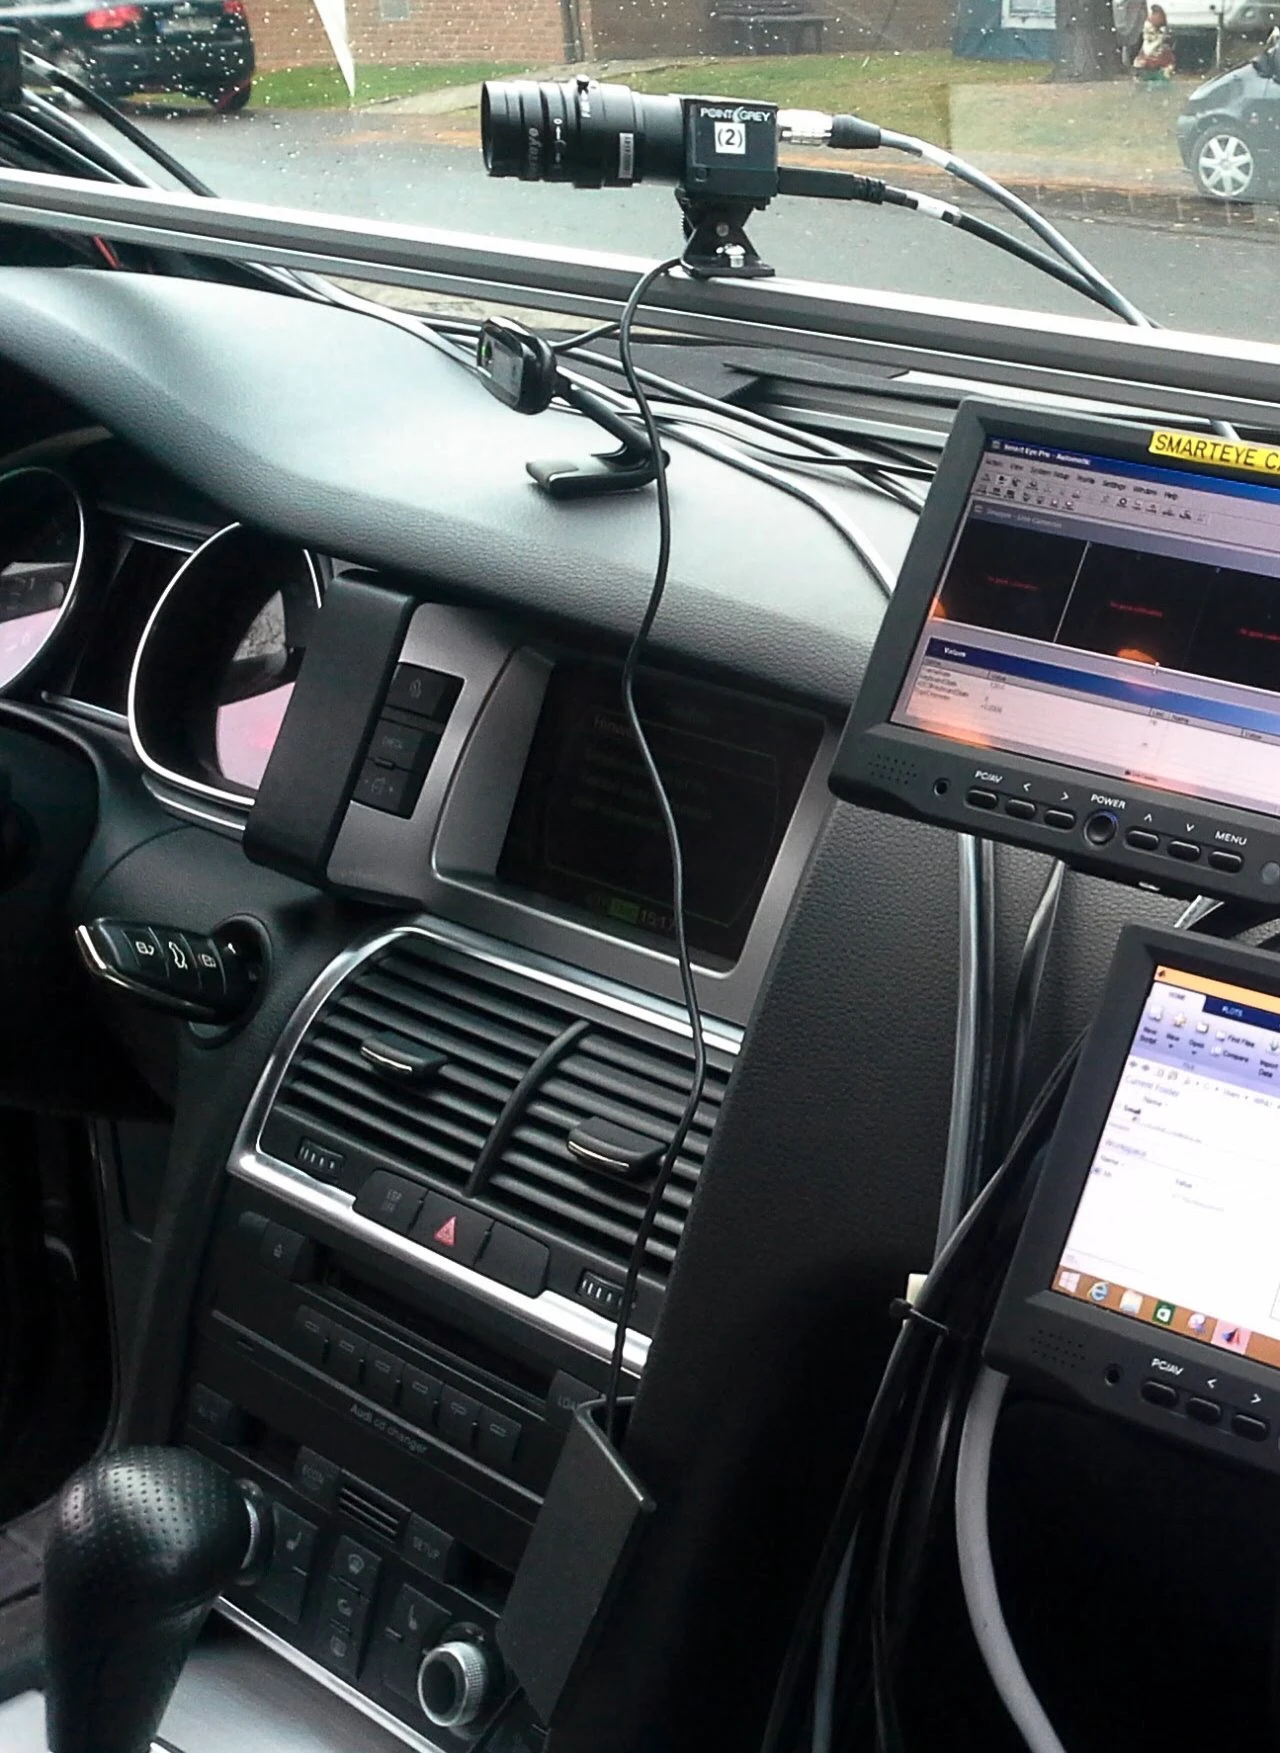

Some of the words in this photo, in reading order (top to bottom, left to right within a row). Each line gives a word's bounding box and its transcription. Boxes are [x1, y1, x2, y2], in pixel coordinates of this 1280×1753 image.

[700, 106, 732, 120] POINT
[739, 111, 771, 123] GREY
[716, 128, 744, 149] (2)
[1155, 433, 1259, 467] SMARTEYE
[974, 769, 1004, 785] PC/AV
[1090, 793, 1127, 810] POWER
[1214, 829, 1248, 846] MENU
[1220, 1005, 1244, 1018] PLOTS
[1222, 1049, 1250, 1064] Compare
[1151, 1357, 1184, 1376] PC/AV
